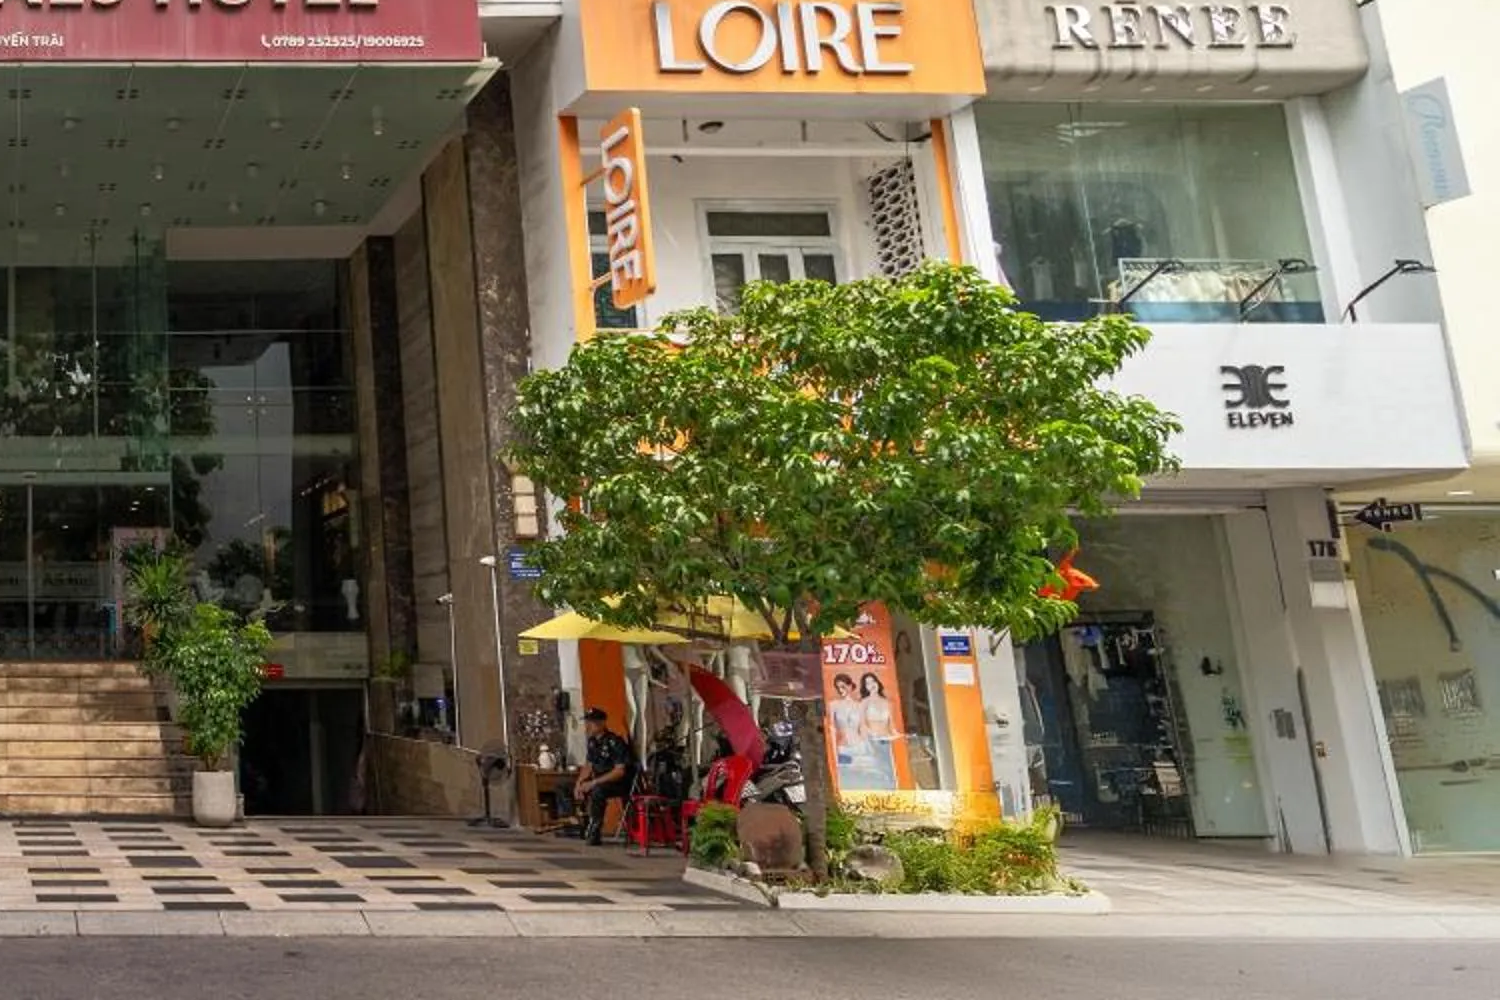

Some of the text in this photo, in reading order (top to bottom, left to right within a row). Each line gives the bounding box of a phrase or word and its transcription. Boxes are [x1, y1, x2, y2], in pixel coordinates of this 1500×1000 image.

[654, 0, 915, 76] LOIRE
[601, 125, 643, 294] LOIRE
[1227, 411, 1294, 429] ELEVEN
